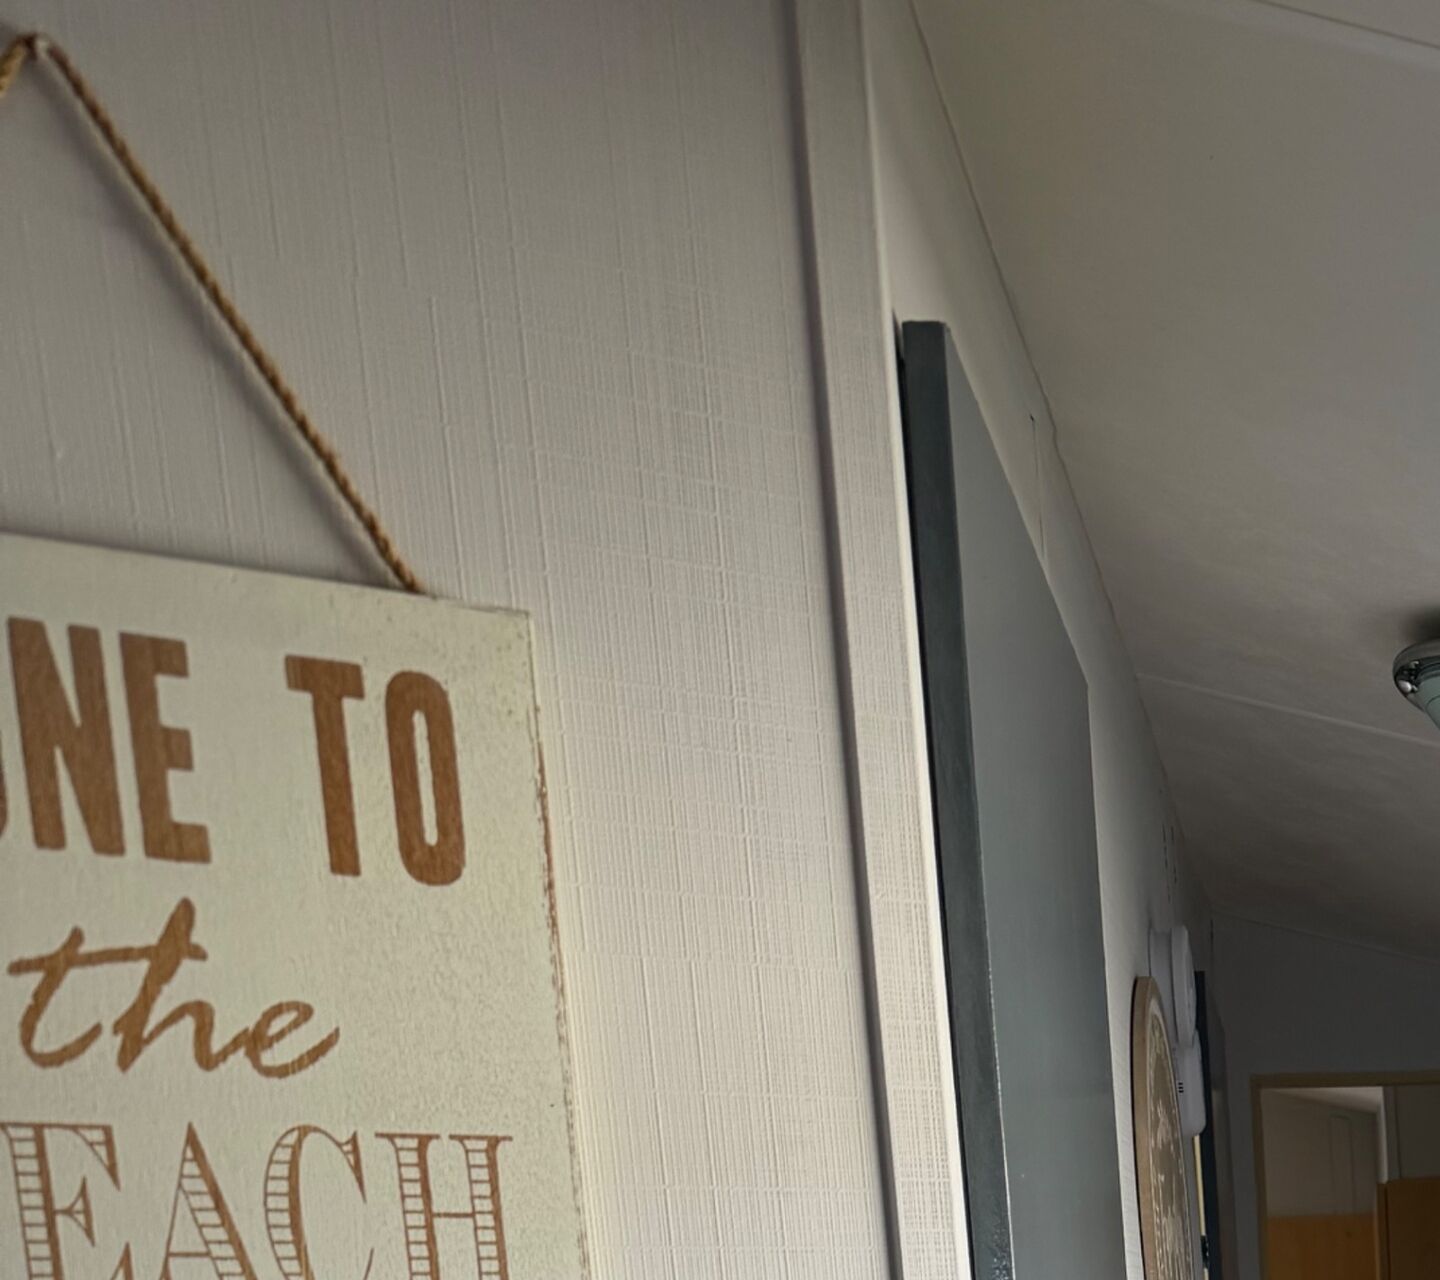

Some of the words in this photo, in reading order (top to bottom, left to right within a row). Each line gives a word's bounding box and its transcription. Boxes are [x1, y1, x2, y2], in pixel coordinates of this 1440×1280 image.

[0, 616, 212, 864] NE
[285, 654, 466, 887] TO
[8, 897, 340, 1079] the
